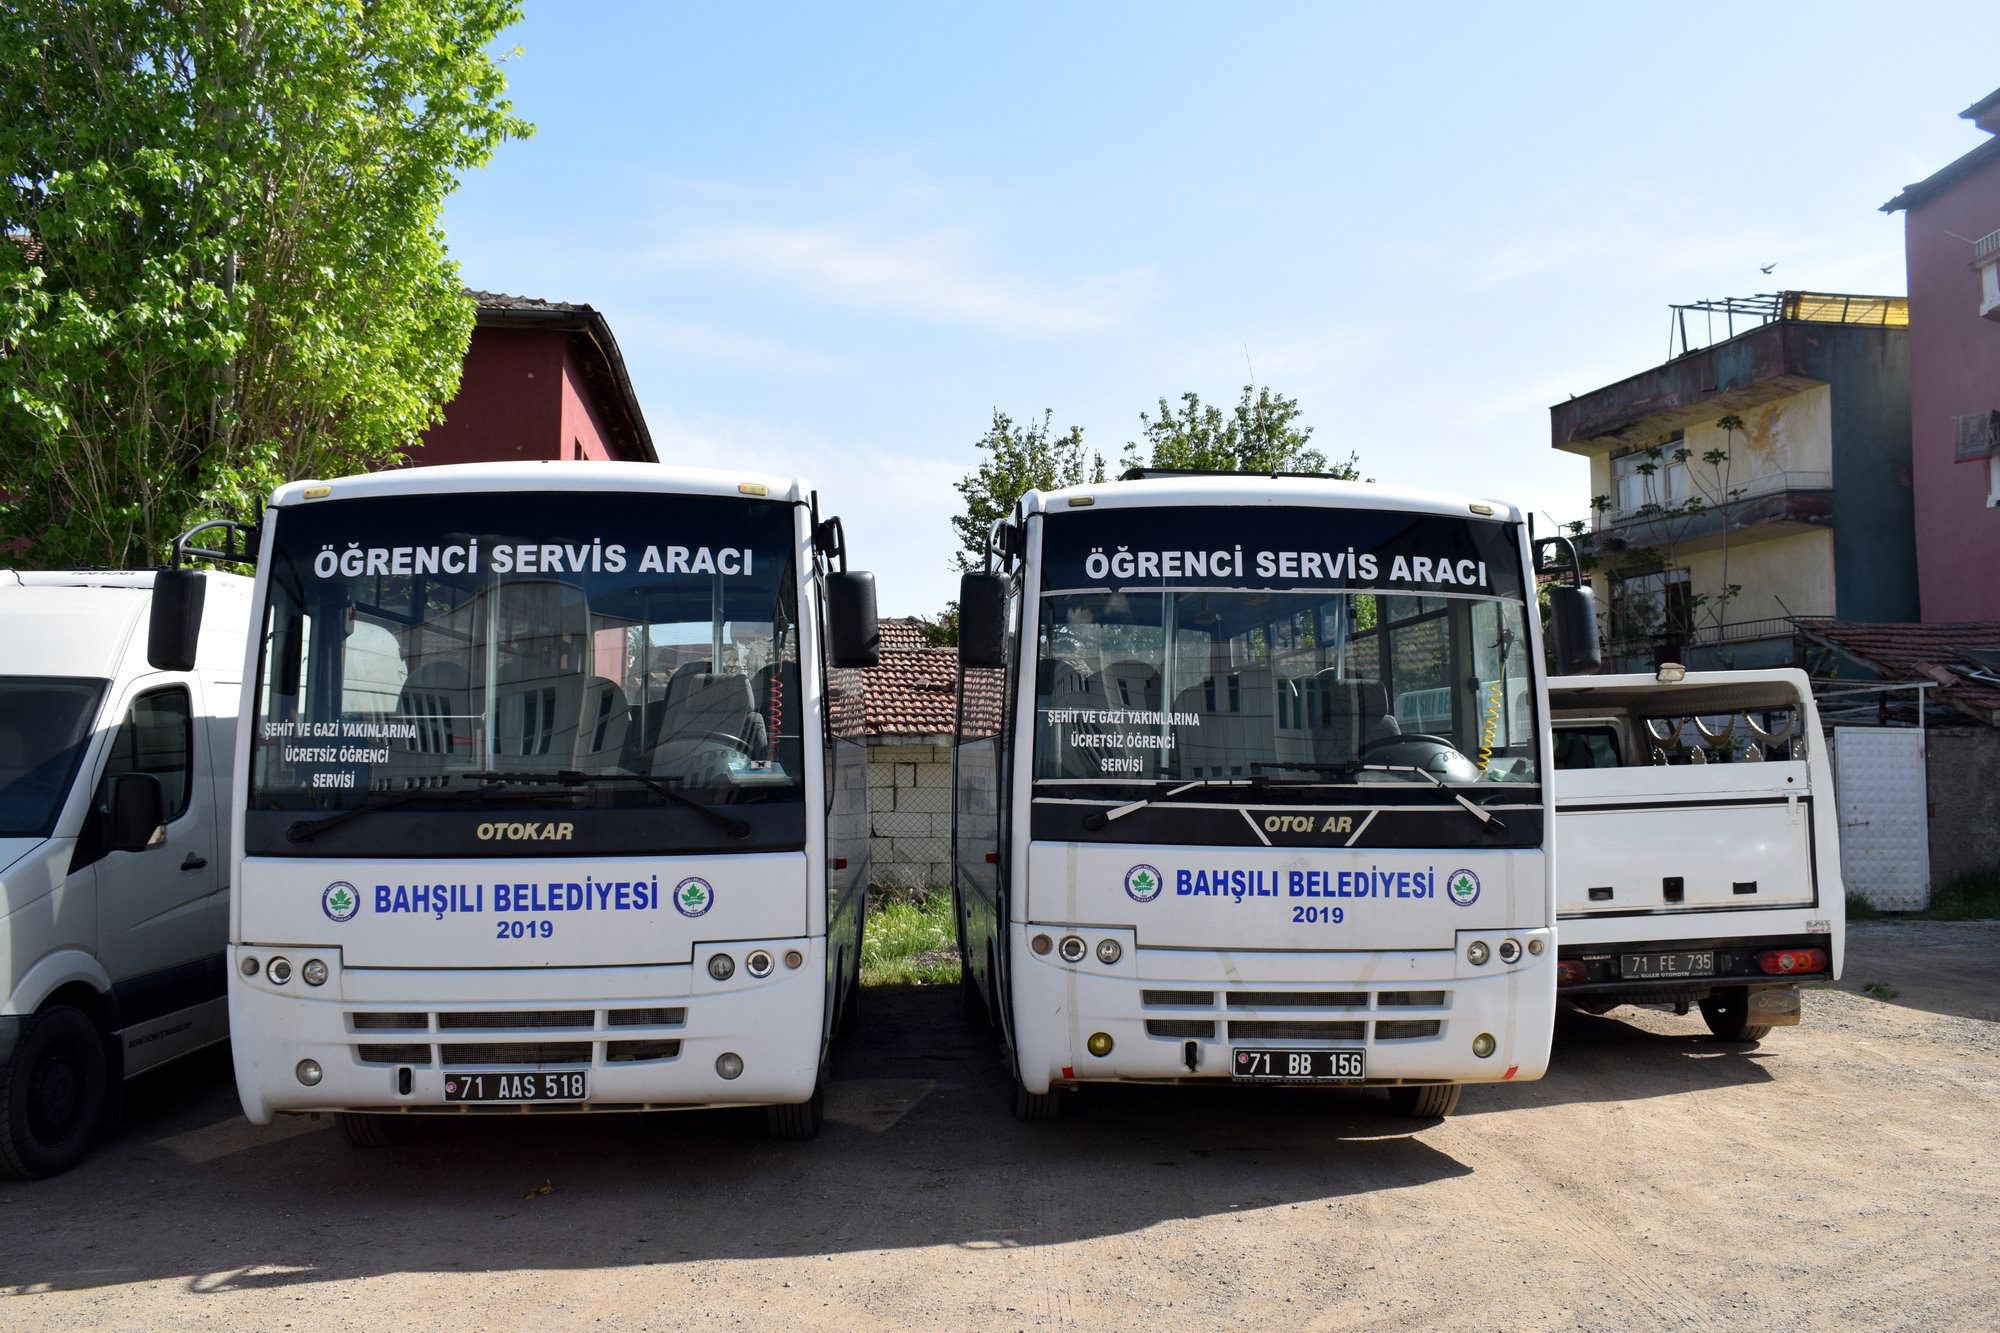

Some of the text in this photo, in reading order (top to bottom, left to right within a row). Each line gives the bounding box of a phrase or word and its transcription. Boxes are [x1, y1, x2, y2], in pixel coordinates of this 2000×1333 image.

[314, 537, 752, 578] ÖĞRENCİ SERVİS ARACI
[1085, 545, 1487, 586] ÖĞRENCİ SERVİS ARACI
[1048, 707, 1200, 726] ŞEHİT VE GAZİ YAKINLARINA
[265, 719, 417, 740] ŞEHİT VE GAZİ YAKINLARINA
[1071, 731, 1175, 749] ÜCRETSİZ ÖĞRENCİ
[285, 745, 389, 763] ÜCRETSİZ ÖĞRENCİ
[1101, 756, 1143, 772] SERVİSİ
[313, 771, 355, 788] SERVİSİ
[477, 822, 574, 841] OTOKAR
[1176, 869, 1280, 904] BAHŞILI
[1288, 865, 1435, 899] BELEDİYESİ
[374, 884, 483, 920] BAHŞILI
[493, 875, 658, 912] BELEDİYESİ
[1292, 906, 1344, 924] 2019
[496, 920, 554, 939] 2019
[1632, 954, 1711, 973] 71 FE 735
[1249, 1053, 1361, 1075] 71 BB 156
[460, 1074, 583, 1099] 71 AAS 518
